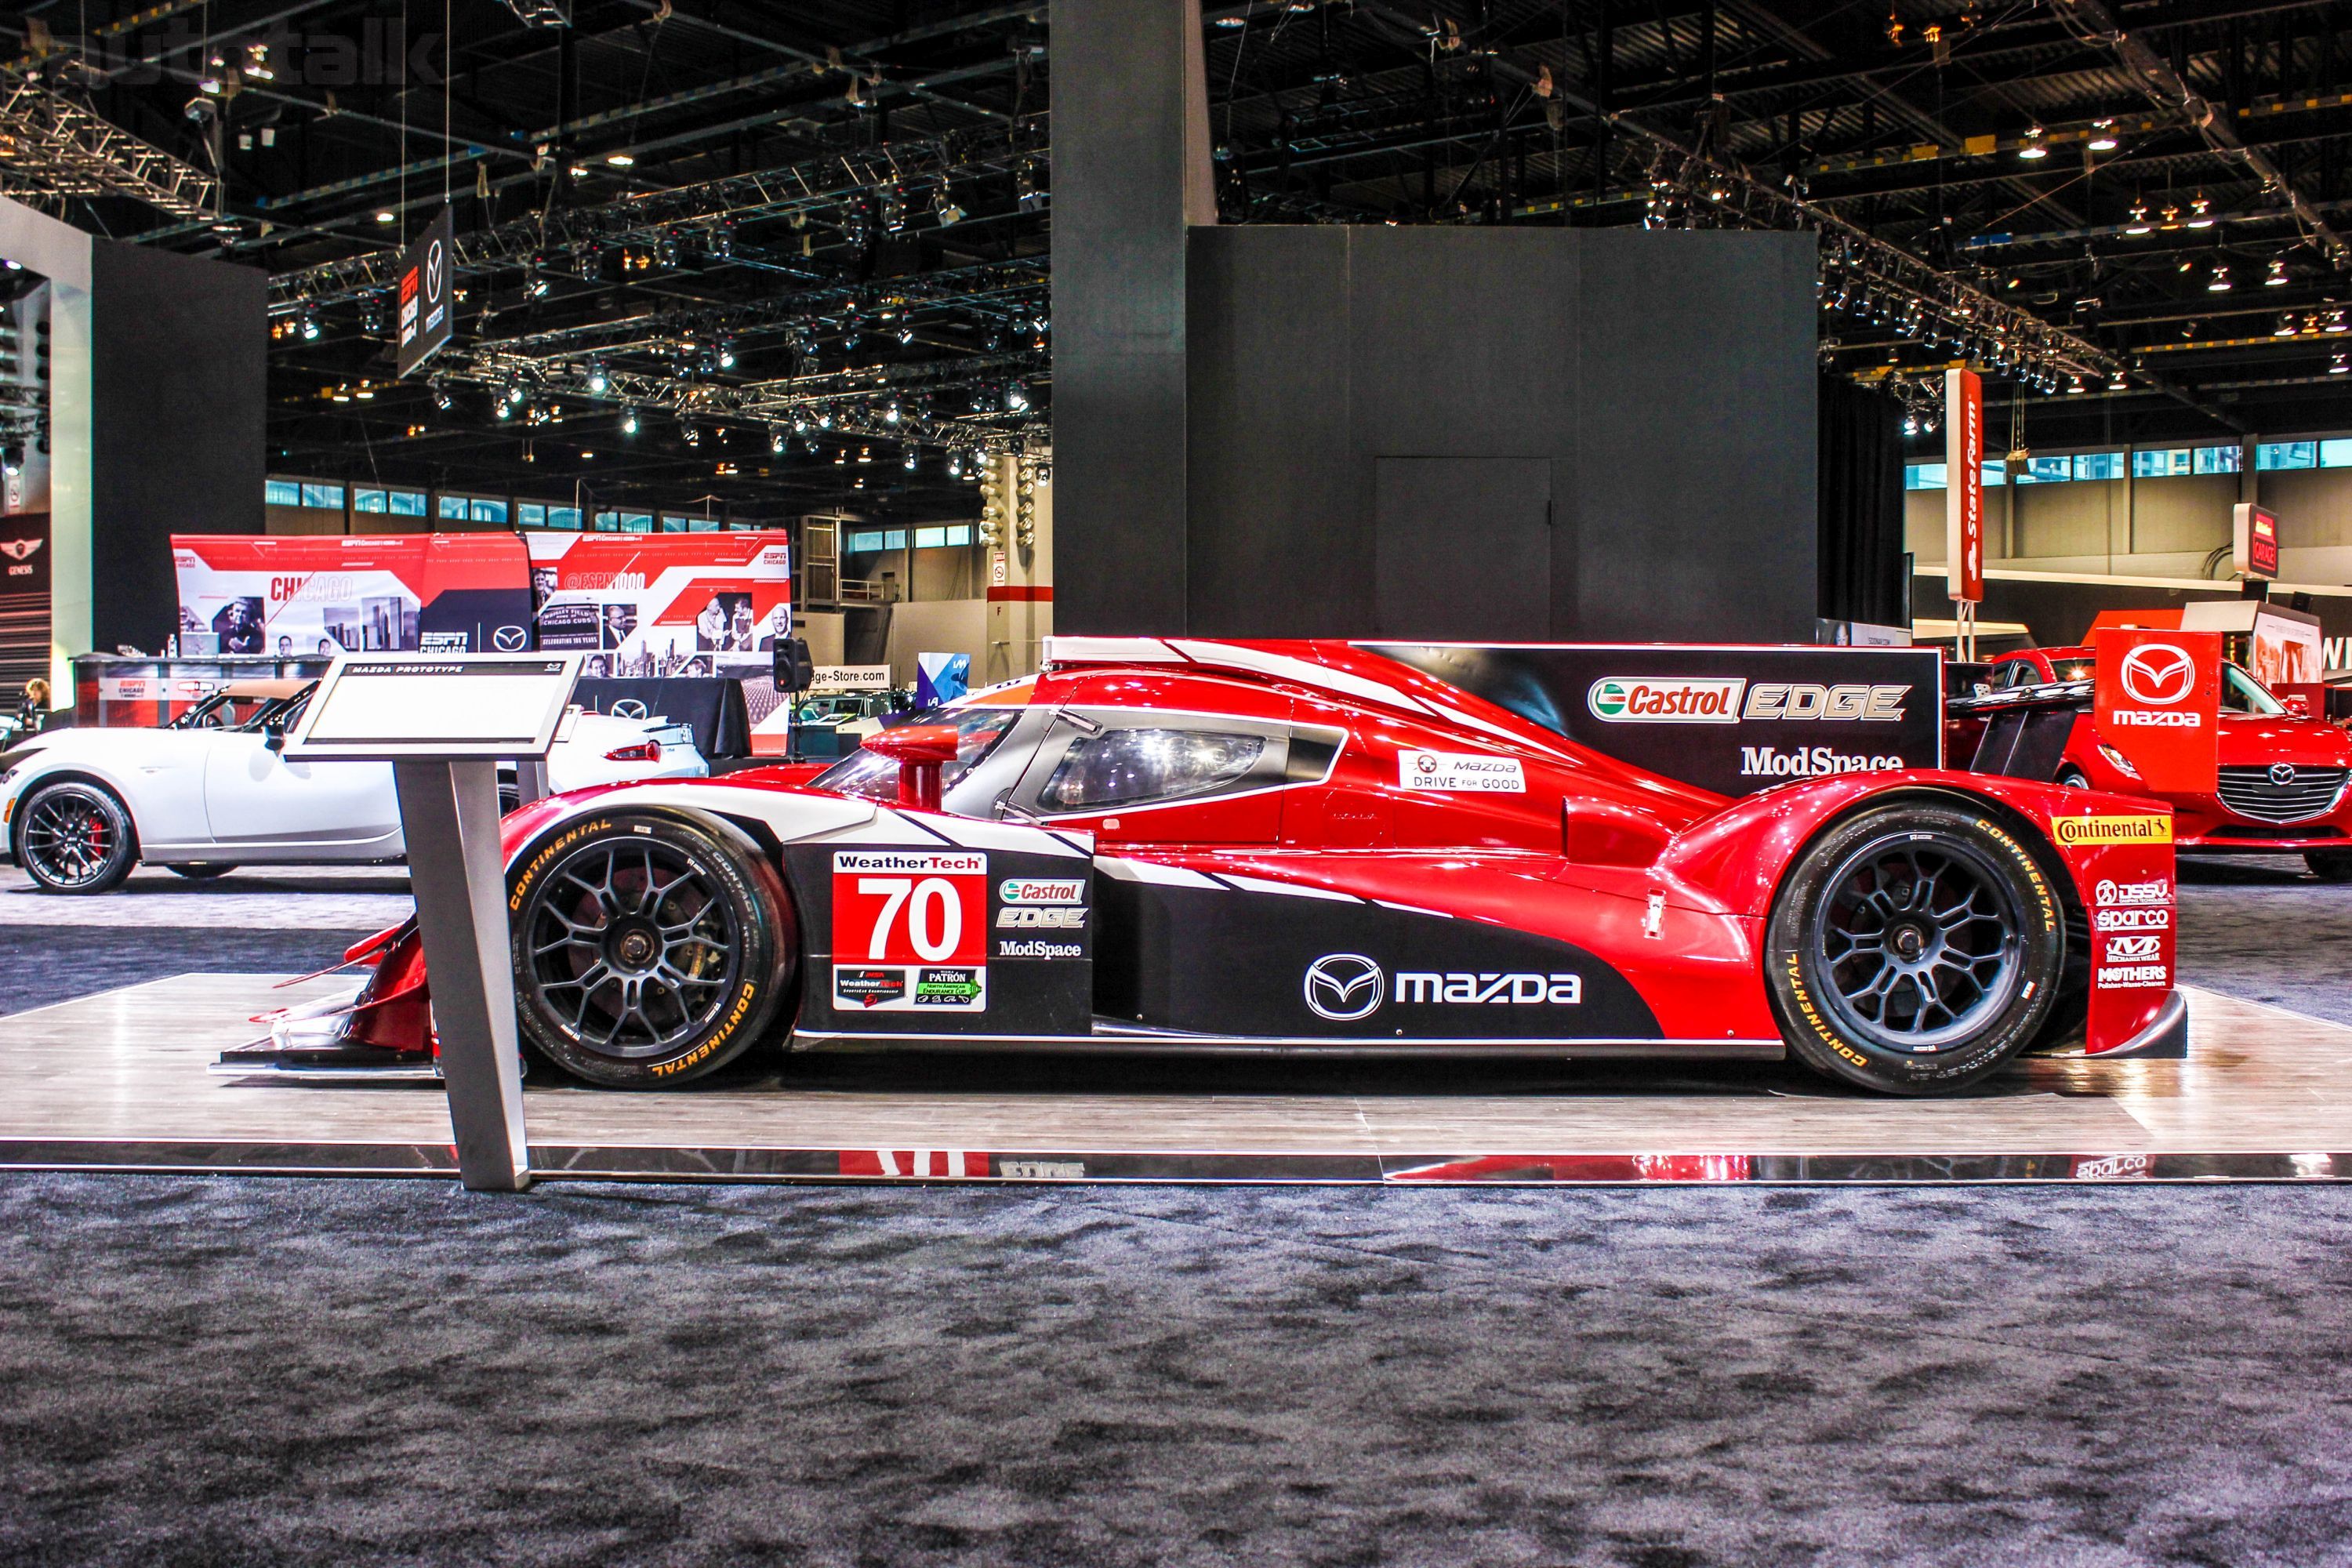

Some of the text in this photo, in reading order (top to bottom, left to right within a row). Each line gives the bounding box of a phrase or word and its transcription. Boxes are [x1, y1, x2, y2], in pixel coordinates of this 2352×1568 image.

[1968, 401, 1977, 539] State Farm
[9, 564, 33, 575] GENESIS
[270, 577, 353, 602] CHICAGO
[564, 572, 646, 590] @ESPN1000
[544, 609, 569, 619] WRIGLEY
[420, 632, 468, 645] ESPN
[1629, 683, 1912, 720] Castrol EDGE
[2113, 710, 2201, 727] mazda
[1740, 747, 1904, 776] ModSpace
[1414, 777, 1457, 788] DRIVE
[1482, 779, 1519, 789] GOOD
[2058, 819, 2153, 843] Continental
[510, 818, 612, 910] CONTINENTAL
[839, 856, 979, 869] WeatherTech
[1976, 818, 2058, 932] CONTINENTAL
[1022, 884, 1076, 899] Castrol
[2118, 883, 2168, 898] DSSV
[858, 877, 962, 961] 70
[996, 907, 1089, 928] EDGE
[2097, 909, 2169, 931] sparco
[1000, 941, 1081, 960] ModSpace
[2140, 953, 2160, 961] WEAR
[929, 972, 966, 982] PATRÓN
[2098, 966, 2166, 982] MOTHERS
[1396, 973, 1582, 1004] mazda
[1786, 953, 1869, 1067] CONTINENTAL
[652, 982, 755, 1077] CONTINENTAL
